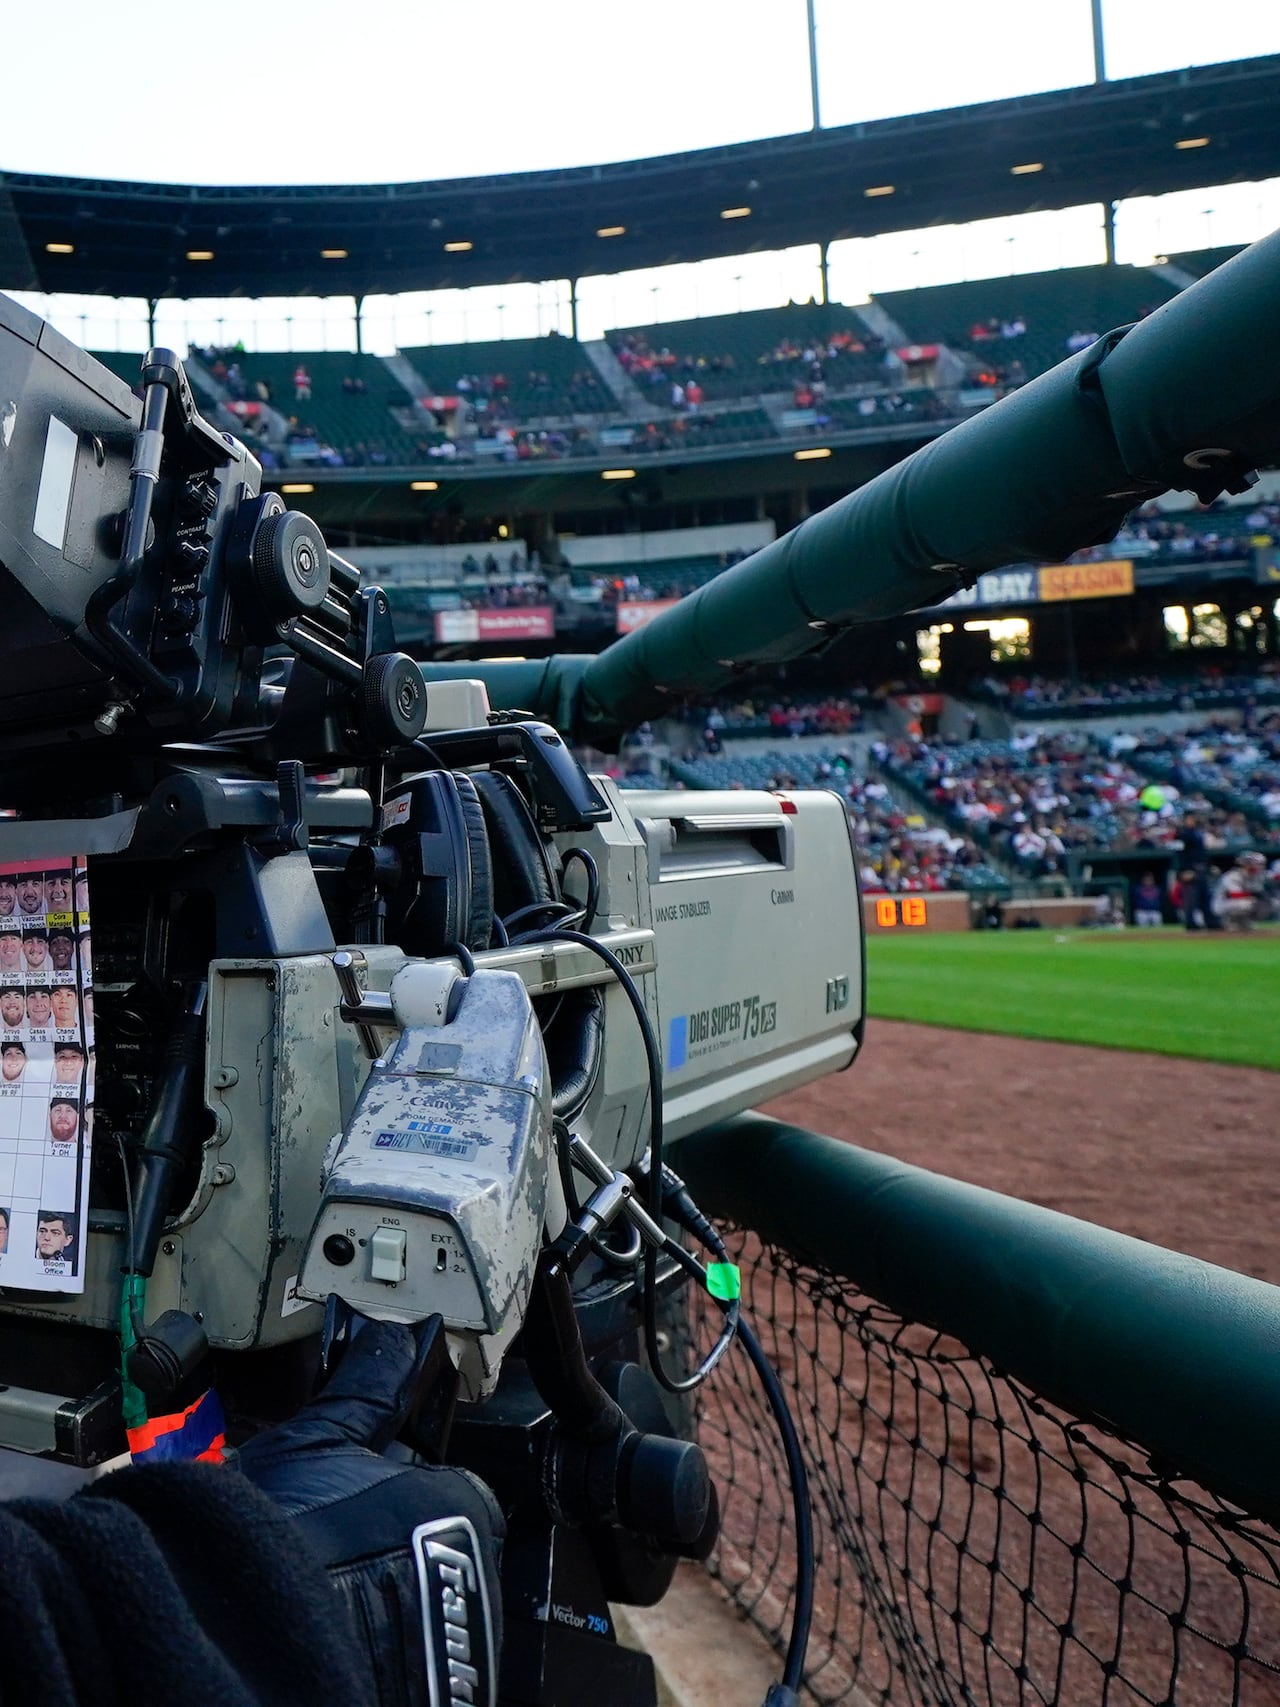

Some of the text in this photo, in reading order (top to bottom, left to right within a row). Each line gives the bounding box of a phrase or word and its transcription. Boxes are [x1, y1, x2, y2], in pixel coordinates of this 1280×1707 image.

[1048, 567, 1125, 594] SEASON
[171, 583, 195, 592] PEAKING
[770, 888, 795, 906] Canon
[679, 900, 712, 920] STABILIZER
[48, 920, 72, 928] Manager
[825, 974, 850, 1015] HD
[689, 1009, 710, 1044] DIGI
[711, 1001, 741, 1037] SUPER
[742, 995, 760, 1040] 75
[410, 1096, 460, 1111] Cano
[427, 1116, 464, 1126] DEMAND
[50, 1141, 72, 1149] Turner
[382, 1217, 400, 1226] ENG
[346, 1228, 357, 1237] IS
[431, 1234, 456, 1246] EXT.
[455, 1250, 465, 1258] 1x
[43, 1259, 66, 1267] Bloom
[44, 1267, 63, 1275] Office
[453, 1265, 467, 1273] 2x
[423, 1540, 479, 1707] Frank
[552, 1603, 609, 1634] Vector 750
